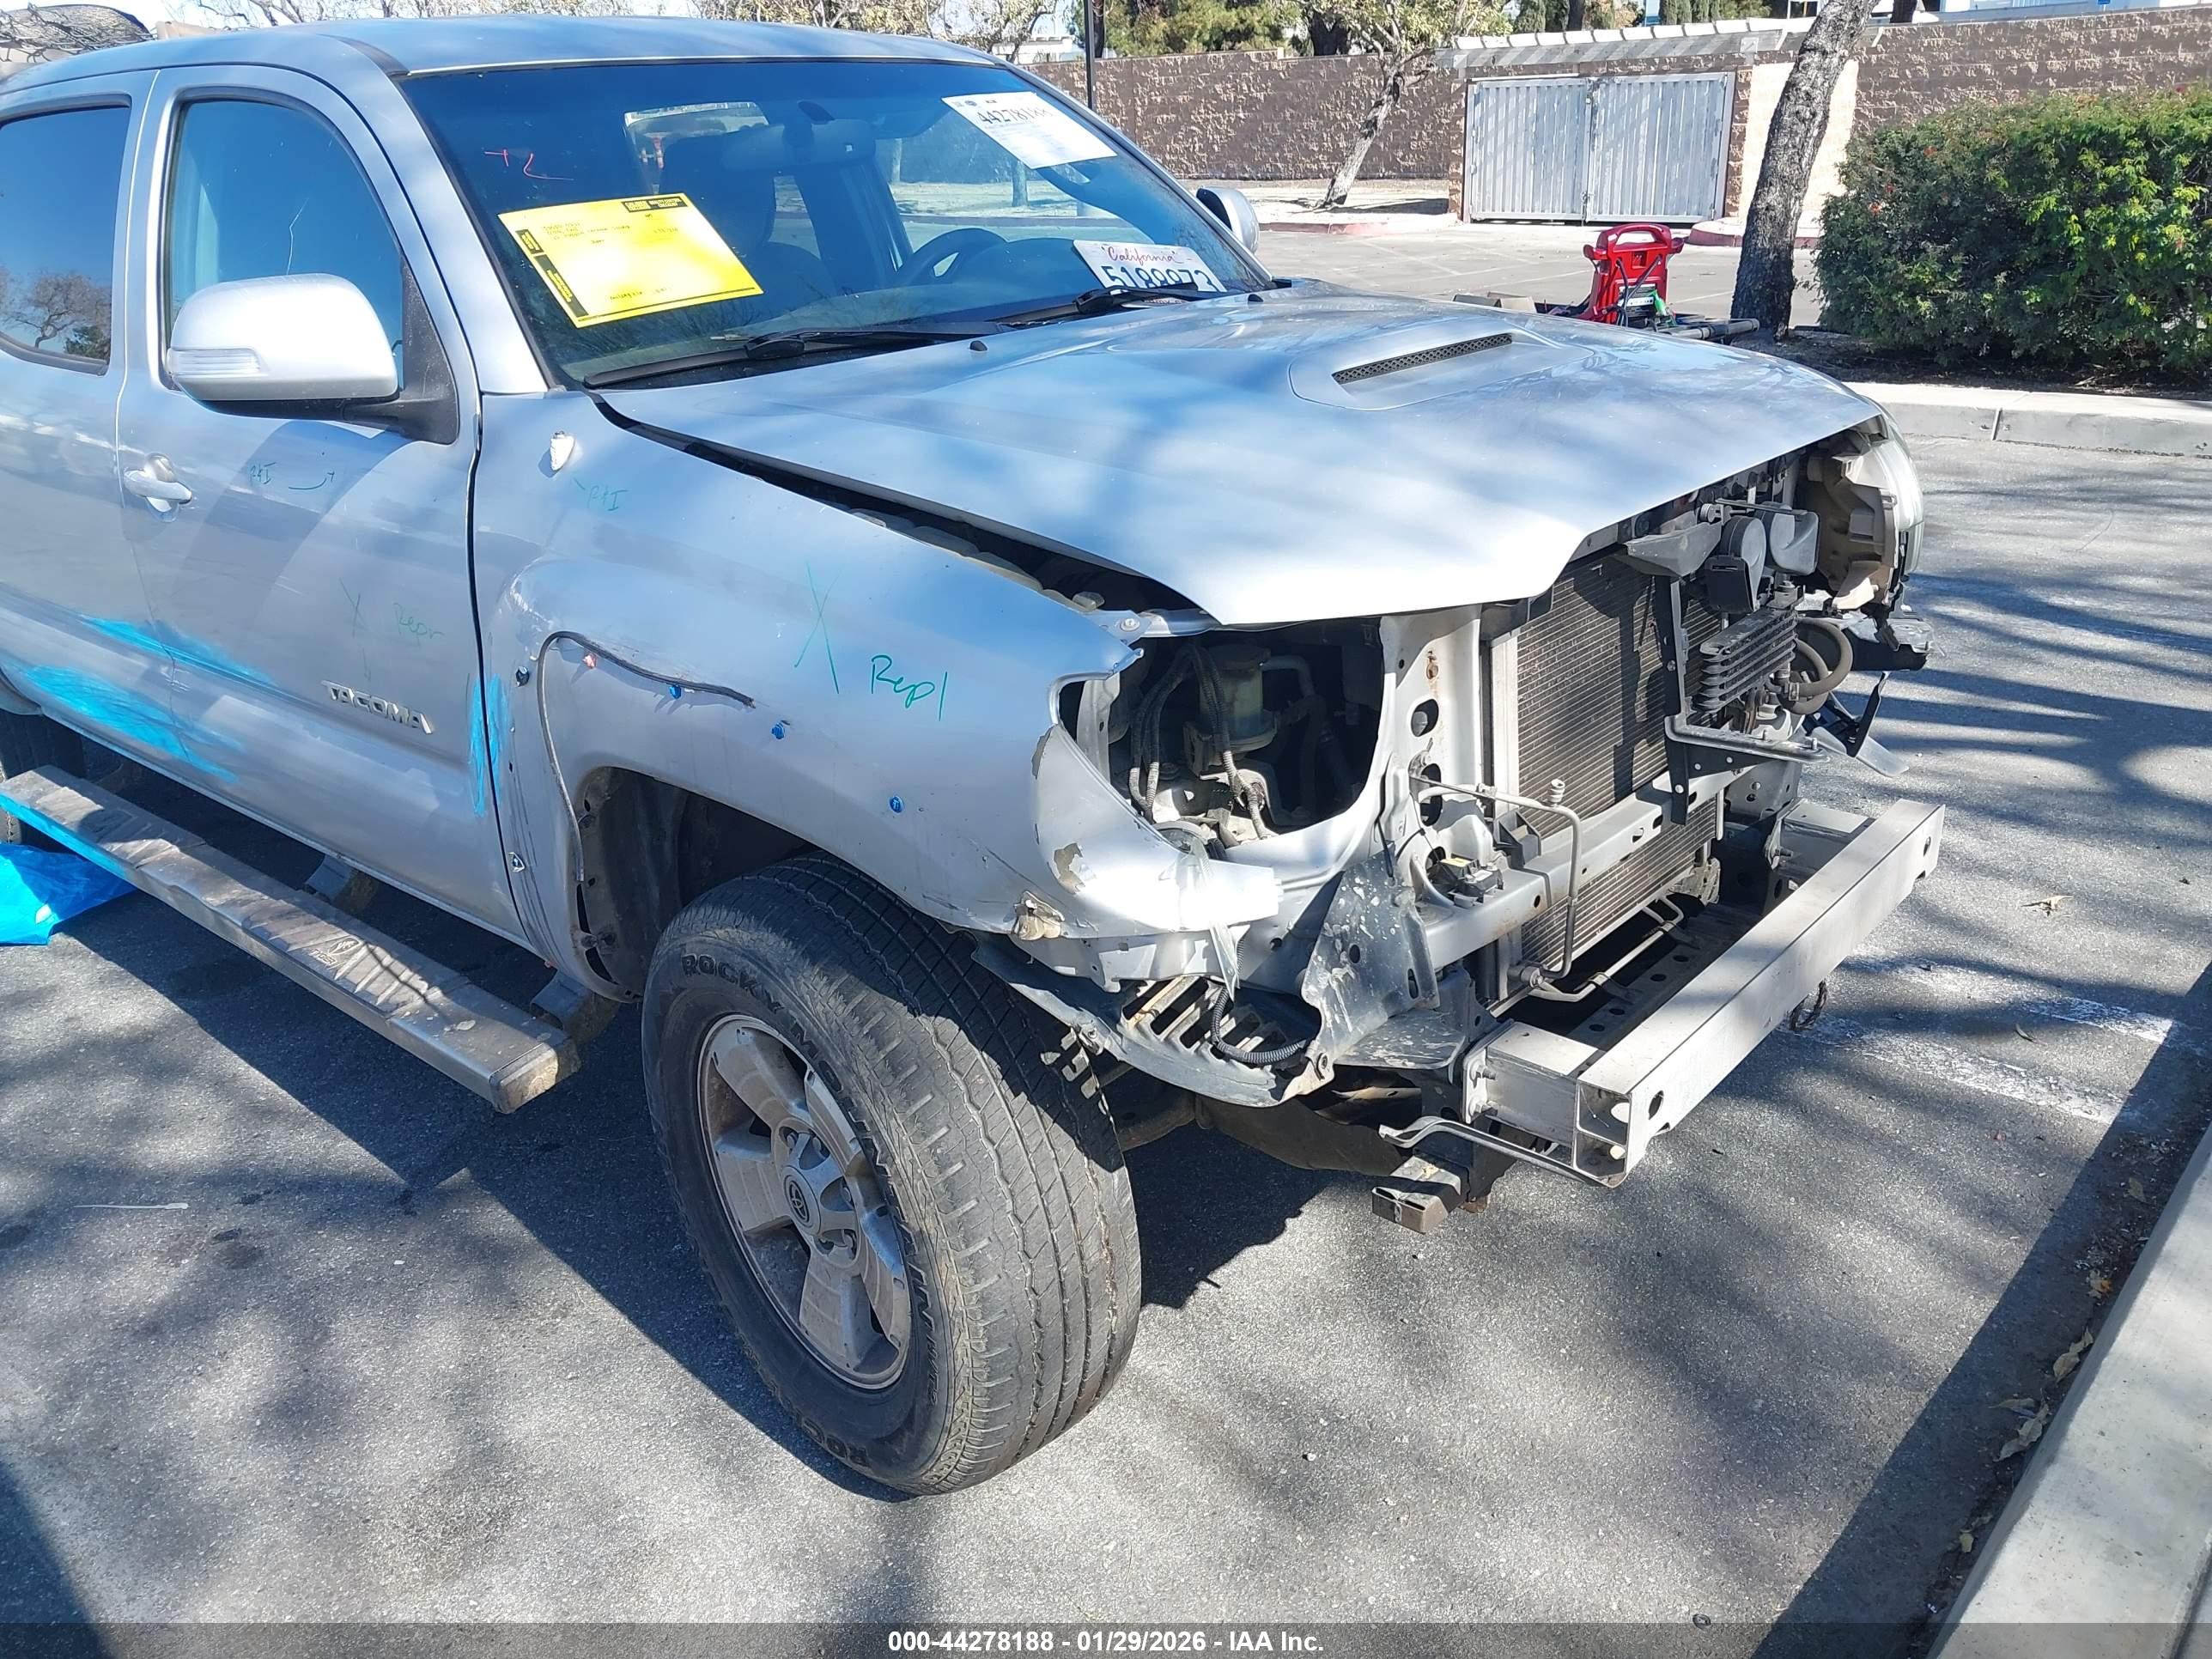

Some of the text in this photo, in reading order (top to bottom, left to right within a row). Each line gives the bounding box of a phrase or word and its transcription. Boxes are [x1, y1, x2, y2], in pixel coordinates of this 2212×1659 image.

[1108, 246, 1183, 266] California
[320, 679, 433, 734] TACOMA
[680, 951, 785, 1015] ROCKY
